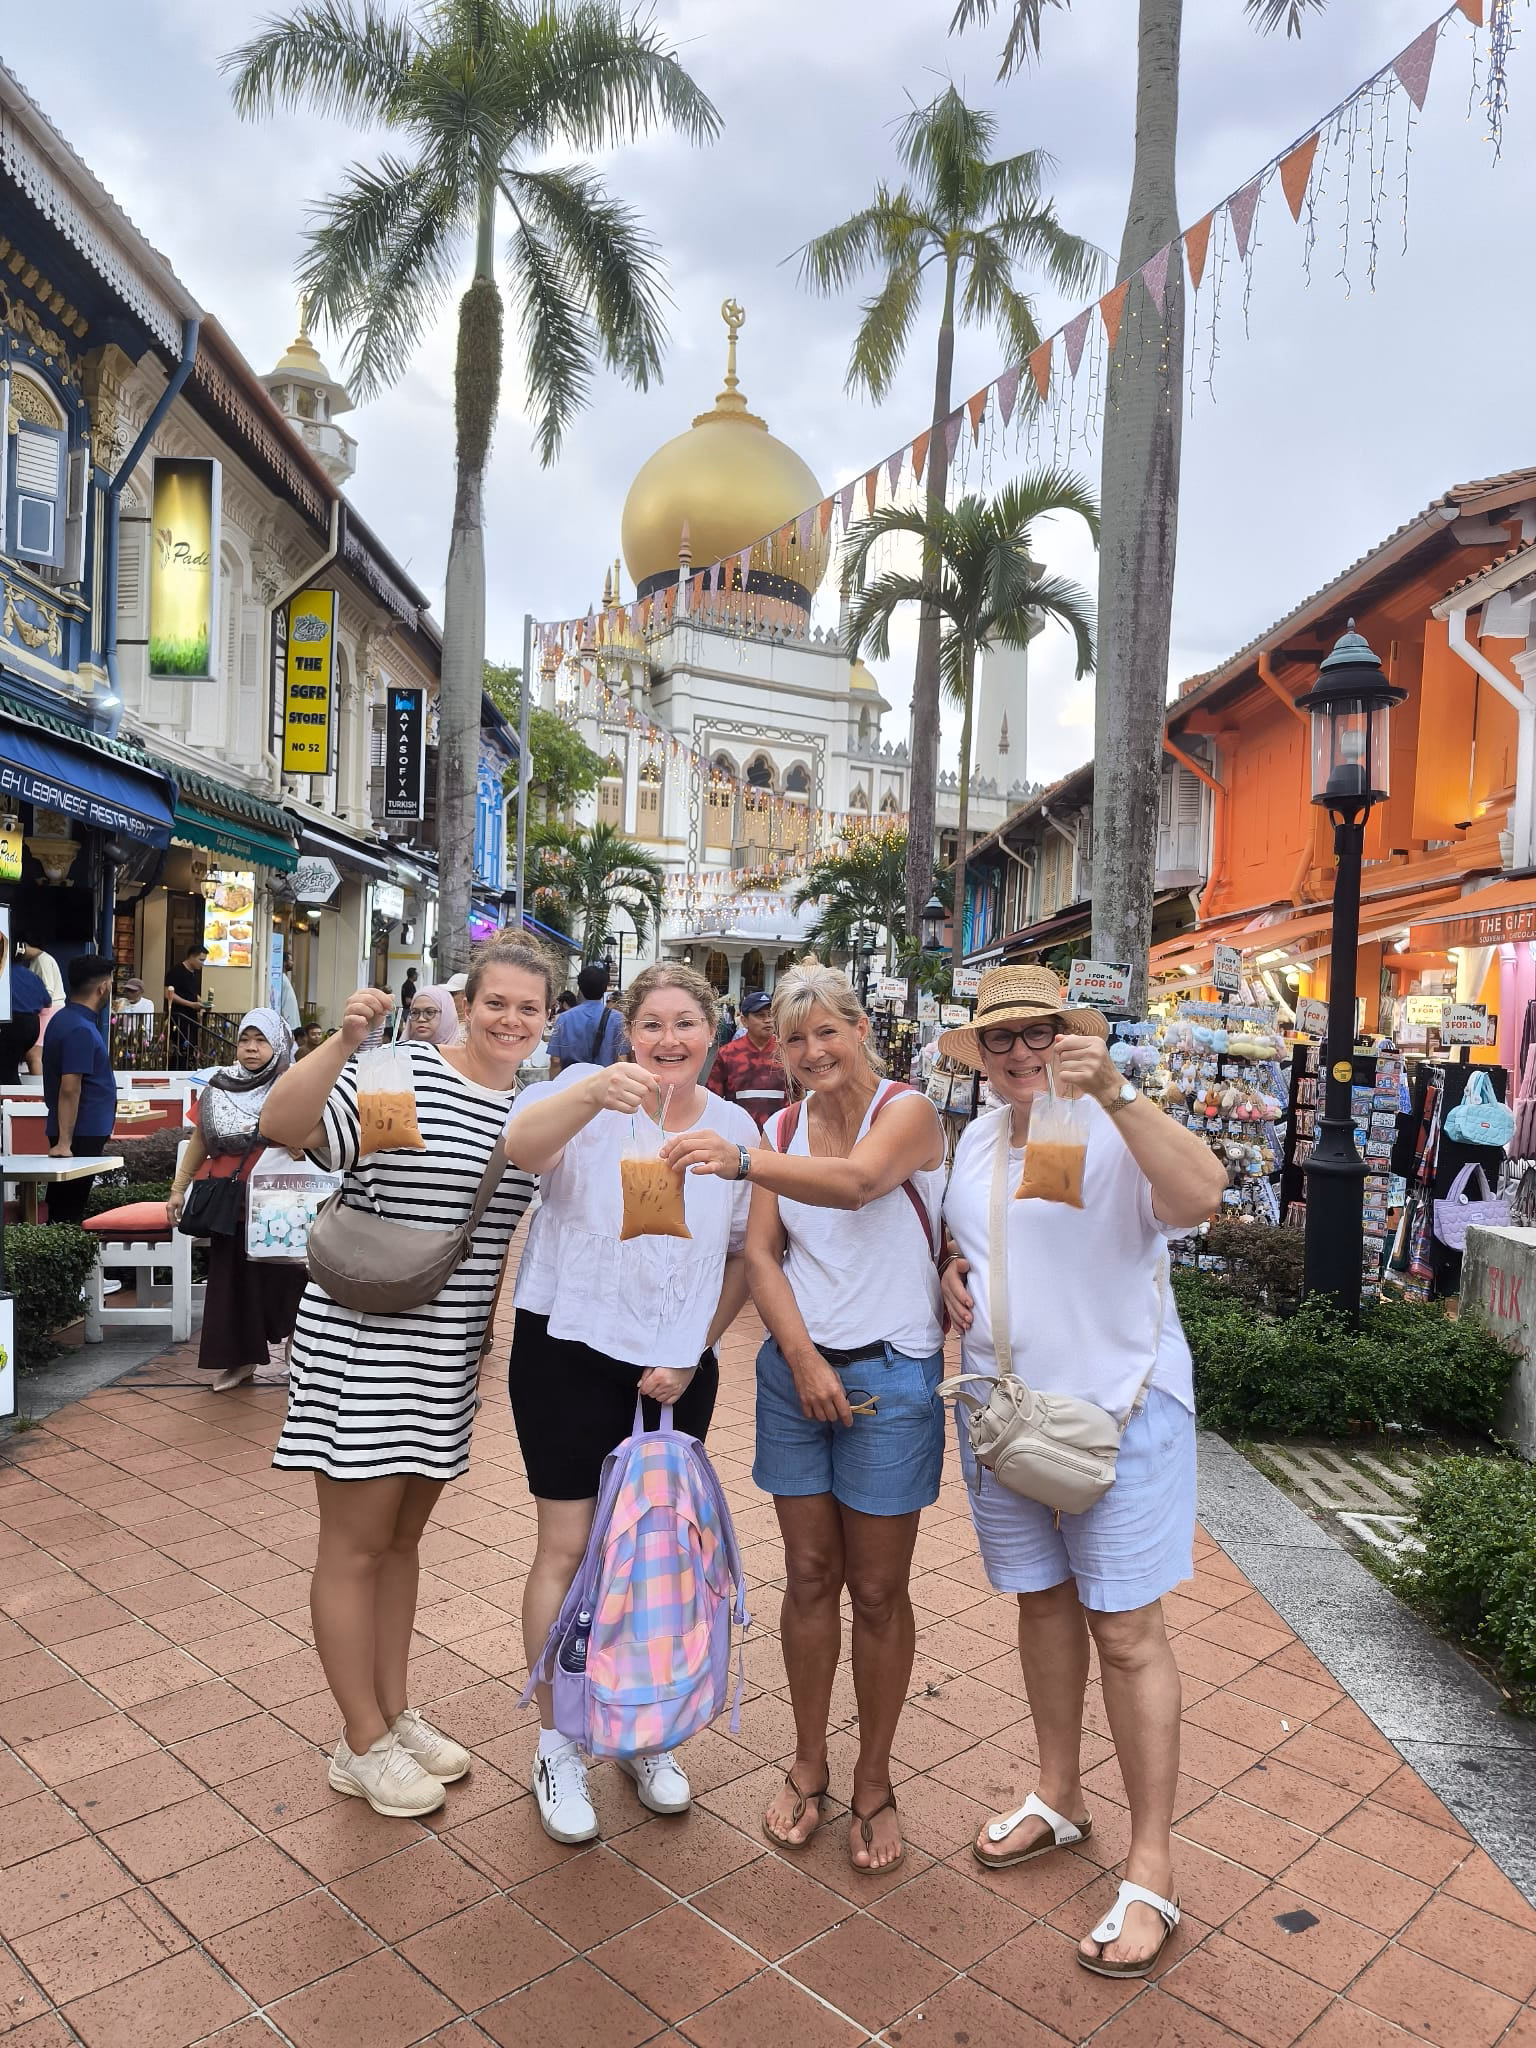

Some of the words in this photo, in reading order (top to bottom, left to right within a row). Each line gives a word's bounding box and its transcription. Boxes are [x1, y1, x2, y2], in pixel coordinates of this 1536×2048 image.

[174, 542, 210, 566] Padi
[296, 656, 323, 671] THE
[290, 684, 327, 700] SGFR
[289, 712, 326, 725] STORE
[291, 742, 305, 751] NO
[308, 743, 320, 752] 52
[398, 712, 409, 797] AYASOFYA
[23, 777, 88, 816] LEBANESE
[89, 803, 155, 839] RESTAURANT
[388, 800, 417, 808] TURKISH
[1480, 917, 1501, 933] THE
[1506, 913, 1533, 930] GIFT
[1222, 963, 1232, 972] FOR
[1075, 978, 1082, 986] 2
[1084, 978, 1105, 988] FOR
[1108, 981, 1123, 989] $10
[1307, 1011, 1320, 1020] FOR
[1445, 1021, 1450, 1029] 3
[1451, 1021, 1468, 1029] FOR
[1469, 1021, 1482, 1029] $10
